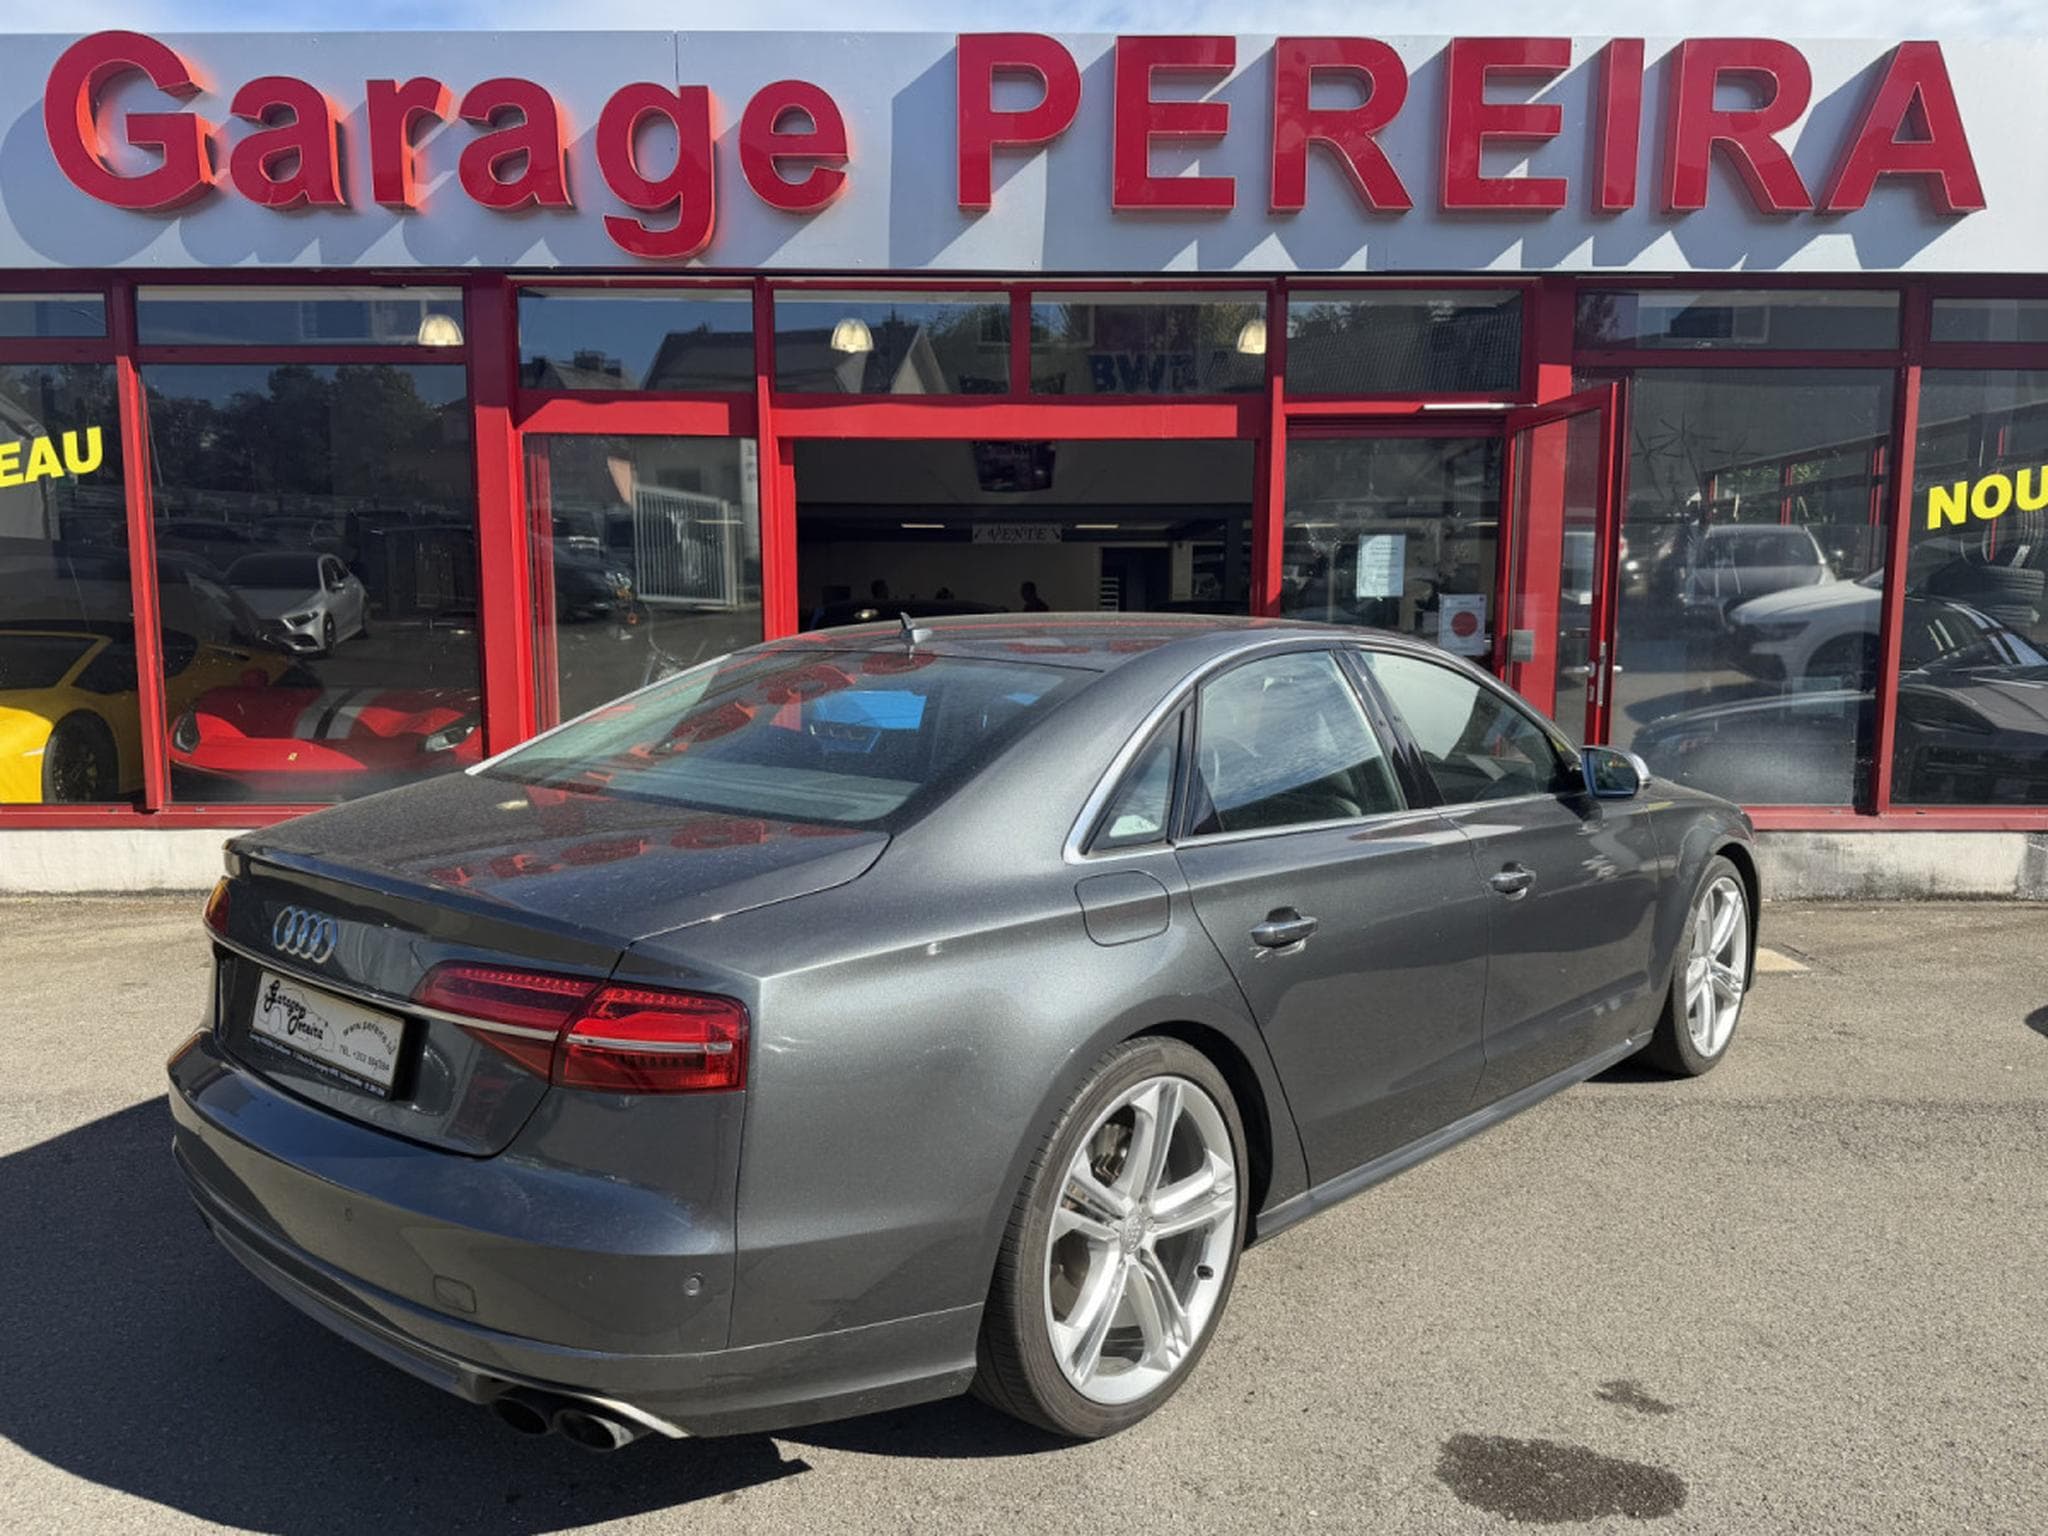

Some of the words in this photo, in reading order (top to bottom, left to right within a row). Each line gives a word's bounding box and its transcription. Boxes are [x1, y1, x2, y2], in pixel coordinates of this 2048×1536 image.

[44, 29, 851, 260] Garage
[956, 32, 1987, 214] PEREIRA
[0, 426, 103, 488] EAU
[1927, 464, 2048, 531] NOU
